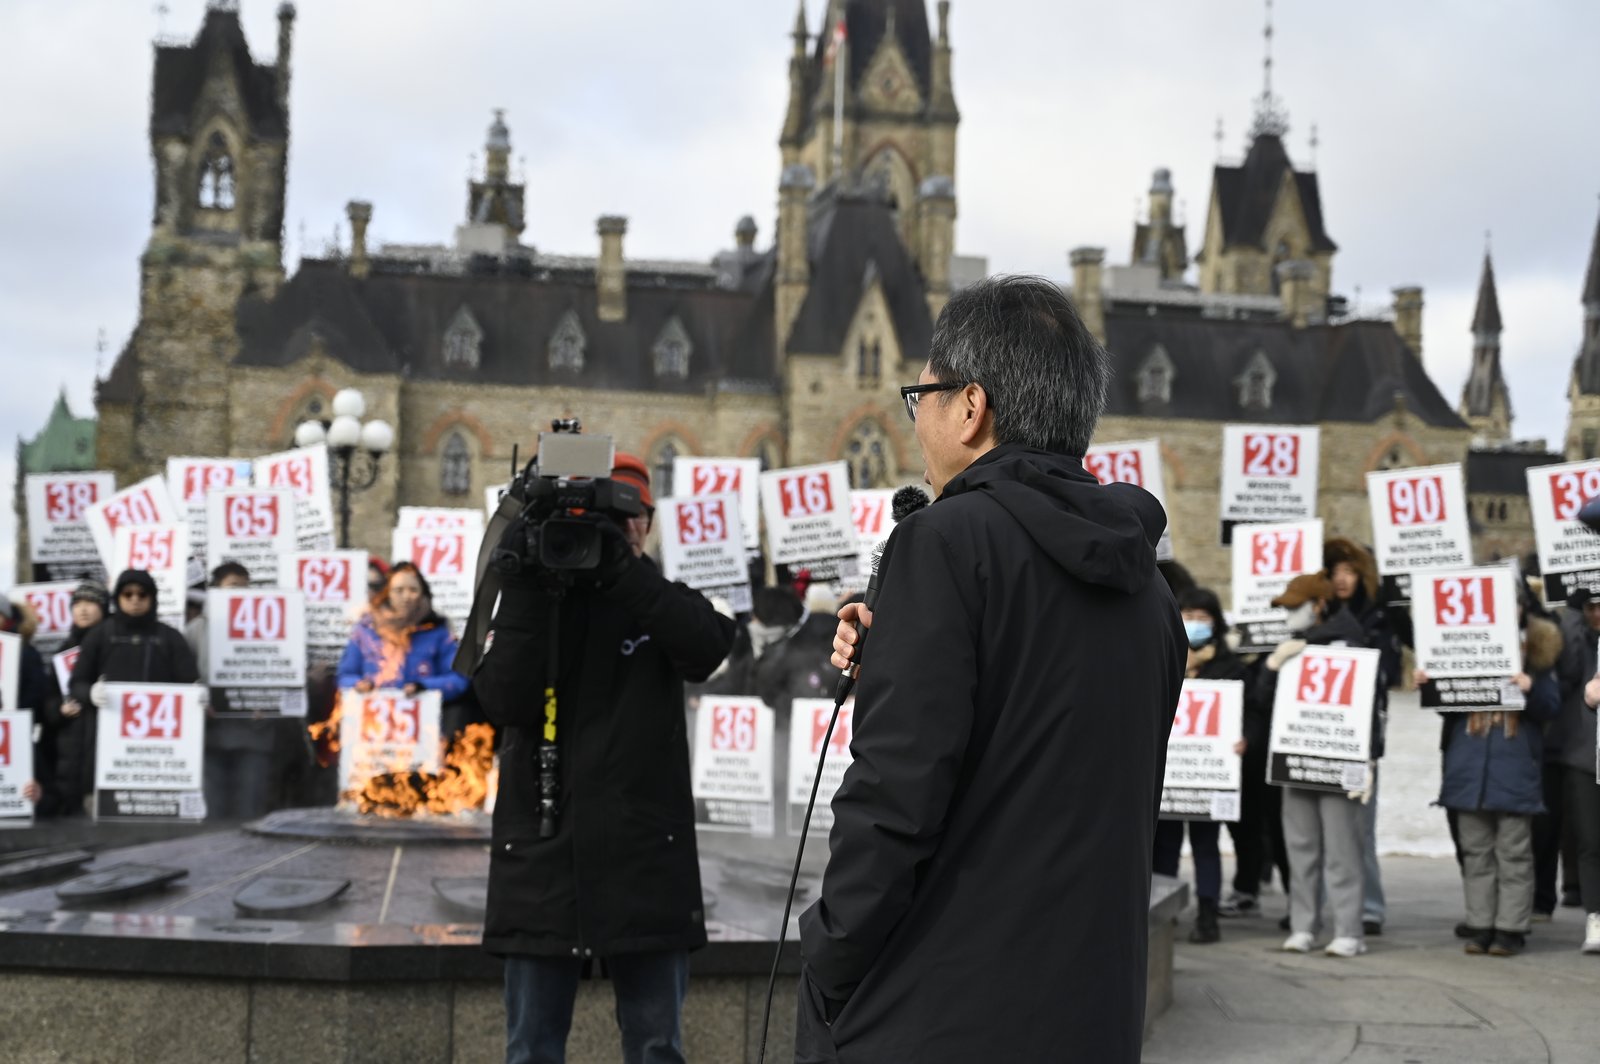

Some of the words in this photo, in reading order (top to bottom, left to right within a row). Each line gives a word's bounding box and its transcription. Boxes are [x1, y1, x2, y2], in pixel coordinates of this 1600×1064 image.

[1089, 452, 1139, 485] 36
[1247, 434, 1295, 476] 28
[53, 483, 94, 521] 38
[230, 495, 274, 537] 65
[784, 473, 828, 518] 16
[1391, 478, 1441, 524] 90
[682, 501, 726, 544] 35
[131, 531, 171, 570] 55
[416, 534, 461, 576] 72
[1256, 529, 1301, 575] 37
[302, 559, 346, 601] 62
[1440, 577, 1491, 625] 31
[32, 592, 73, 633] 30
[232, 596, 282, 640] 40
[1302, 656, 1353, 706] 37
[125, 693, 178, 740] 34
[366, 698, 417, 743] 35
[714, 707, 755, 751] 36
